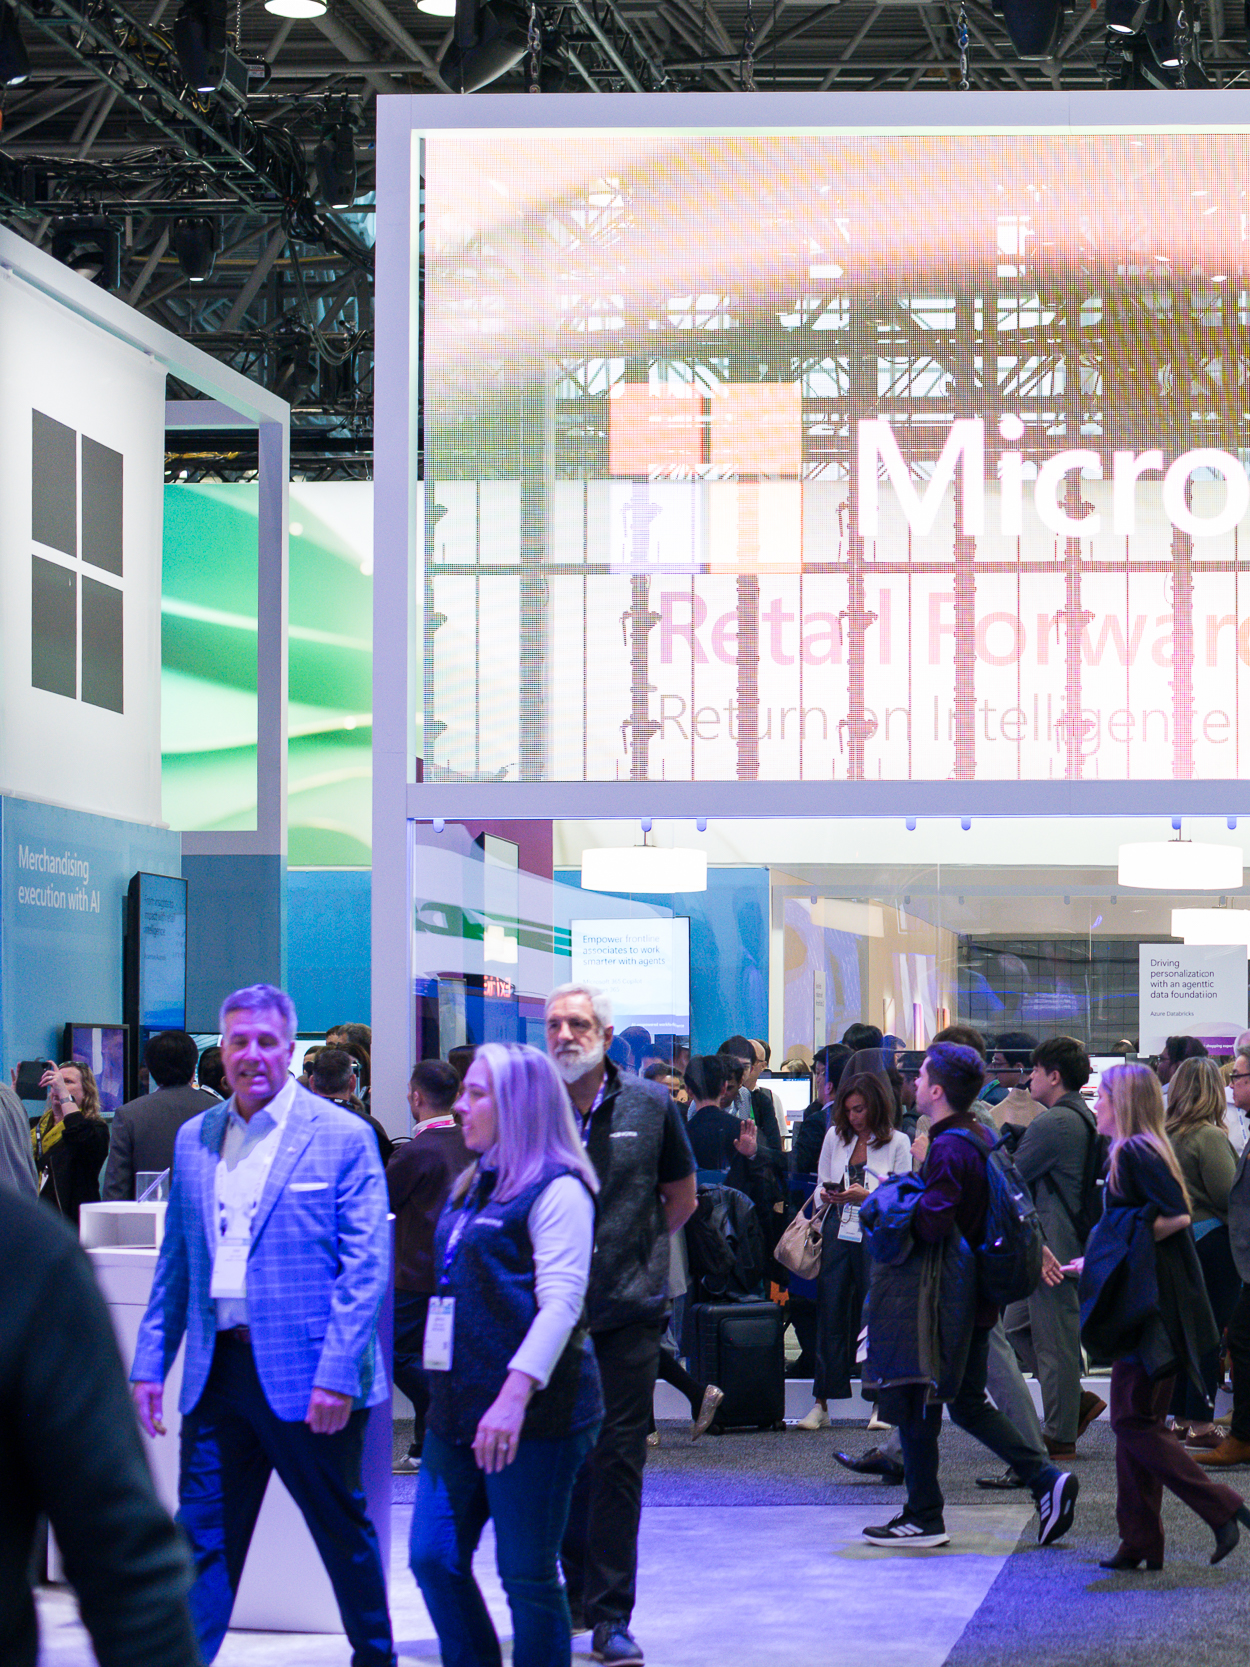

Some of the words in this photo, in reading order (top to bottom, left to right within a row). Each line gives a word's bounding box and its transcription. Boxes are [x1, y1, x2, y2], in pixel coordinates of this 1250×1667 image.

[660, 588, 891, 666] Retal
[934, 693, 1231, 757] Itelligene
[18, 844, 89, 885] Merchandising
[18, 883, 66, 909] execution
[67, 886, 89, 912] with
[89, 890, 100, 913] AI
[582, 935, 623, 945] Empower
[625, 934, 660, 943] frontline
[582, 946, 628, 954] associates
[629, 946, 639, 954] to
[640, 945, 661, 954] work
[582, 958, 616, 966] smarter
[618, 957, 637, 965] with
[638, 957, 666, 967] agents
[1150, 958, 1180, 970] Driving
[1150, 980, 1168, 988] with
[1150, 990, 1169, 999] data
